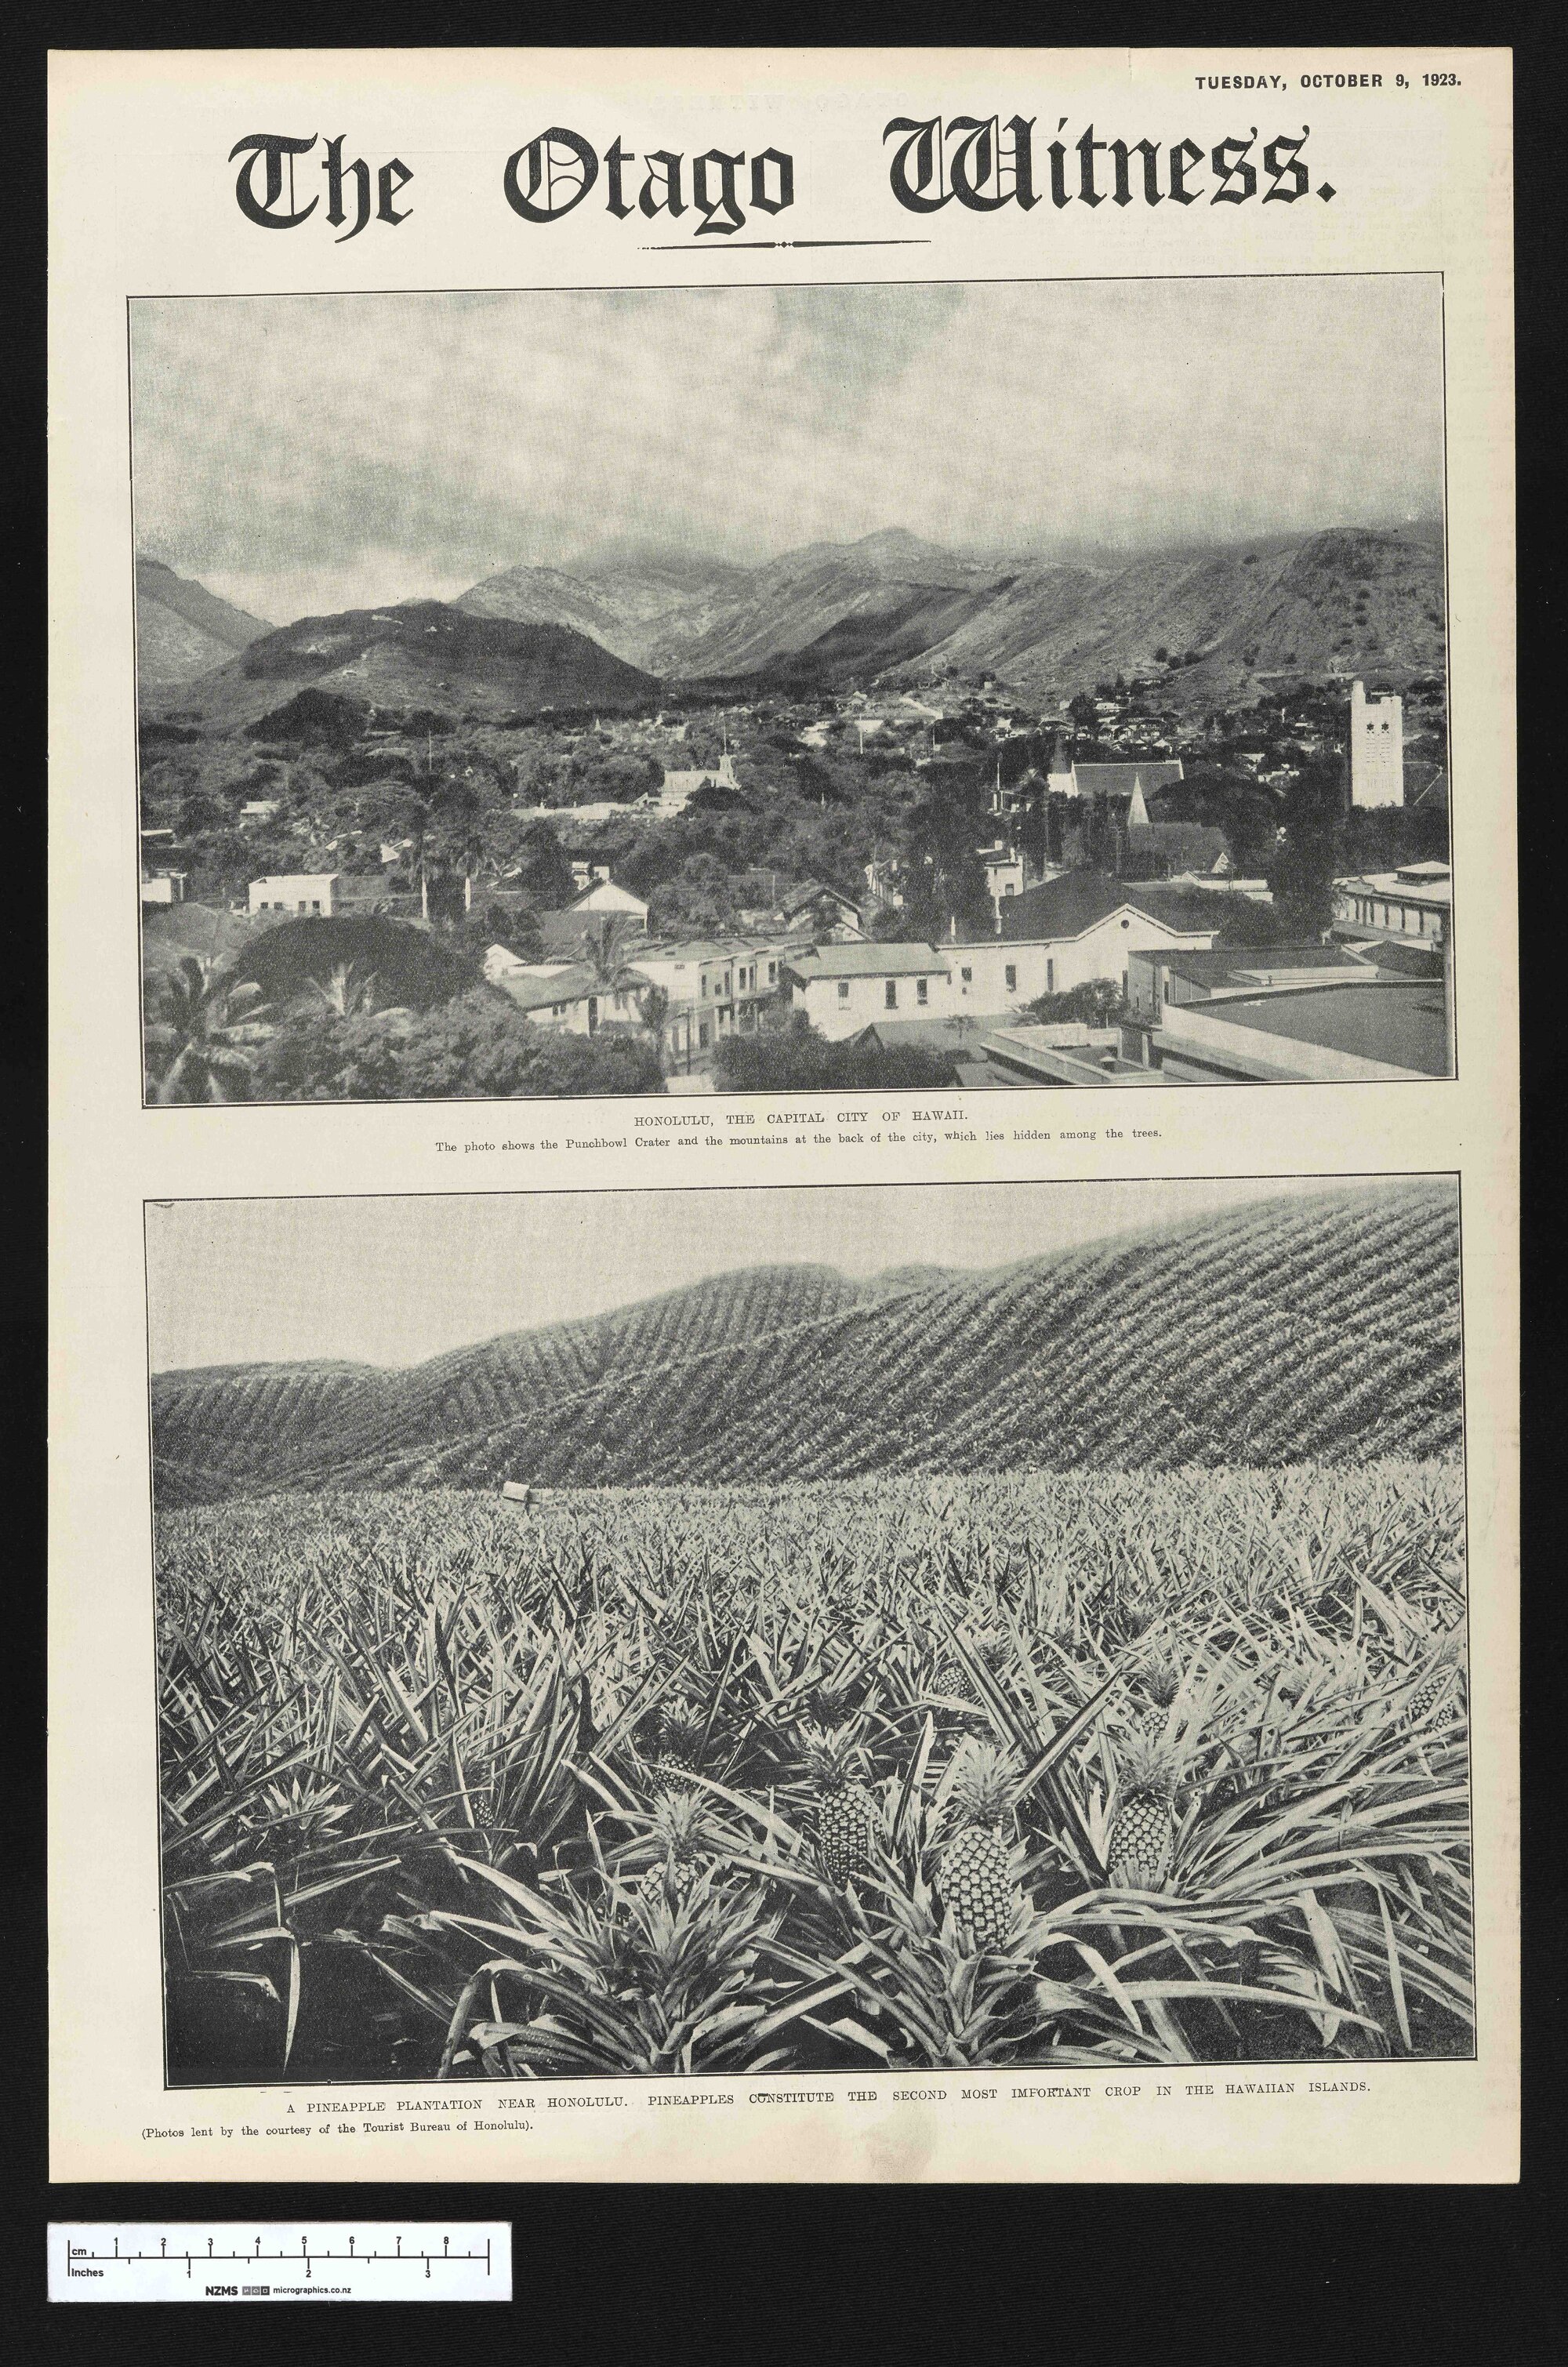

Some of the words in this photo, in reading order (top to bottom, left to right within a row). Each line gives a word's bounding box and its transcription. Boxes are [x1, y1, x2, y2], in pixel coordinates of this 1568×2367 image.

[1195, 75, 1287, 92] TUESDAY,
[1300, 74, 1383, 89] OCTOBER
[1396, 74, 1410, 89] 9,
[1422, 73, 1461, 86] 1923.
[227, 132, 415, 244] The
[503, 126, 794, 237] Otago
[882, 114, 1337, 214] Witness.
[633, 1115, 713, 1127] HONOLULU,
[726, 1114, 755, 1124] THE
[767, 1113, 825, 1124] CAPITAL
[837, 1112, 869, 1123] CITY
[881, 1112, 901, 1122] OF
[912, 1110, 967, 1121] HAWAII.
[435, 1142, 457, 1152] The
[464, 1141, 495, 1153] photo
[502, 1140, 535, 1151] shows
[539, 1139, 558, 1149] the
[565, 1138, 627, 1149] Punchbowl
[635, 1137, 670, 1147] Crater
[677, 1136, 699, 1145] and
[704, 1135, 723, 1145] the
[729, 1135, 788, 1145] mountains
[795, 1134, 807, 1144] at
[813, 1133, 831, 1144] the
[837, 1133, 864, 1143] back
[870, 1132, 881, 1142] of
[887, 1131, 906, 1142] the
[913, 1132, 937, 1143] city,
[944, 1131, 977, 1142] which
[985, 1131, 1005, 1141] lies
[1013, 1130, 1051, 1140] hidden
[1060, 1131, 1097, 1141] among
[1105, 1128, 1123, 1138] the
[1132, 1129, 1162, 1138] trees.
[286, 2104, 296, 2113] A
[307, 2101, 385, 2113] PINEAPPLE
[396, 2100, 483, 2111] PLANTATION
[497, 2098, 535, 2109] NEAR
[547, 2097, 628, 2107] HONOLULU.
[648, 2094, 734, 2106] PINEAPPLES
[848, 2091, 877, 2101] THE
[892, 2089, 947, 2101] SECOND
[961, 2089, 998, 2100] MOST
[1105, 2086, 1142, 2097] CROP
[1156, 2086, 1172, 2096] IN
[1185, 2085, 1214, 2096] THE
[1225, 2083, 1295, 2094] HAWAIIAN
[1308, 2082, 1370, 2093] ISLANDS.
[141, 2128, 184, 2140] (Photos
[191, 2127, 213, 2137] lent
[220, 2126, 234, 2138] by
[241, 2126, 259, 2136] the
[266, 2125, 312, 2136] courtesy
[318, 2123, 331, 2134] of
[337, 2123, 356, 2134] the
[363, 2122, 405, 2133] Tourist
[409, 2122, 451, 2132] Bureau
[456, 2121, 467, 2131] of
[474, 2119, 533, 2132] Honolulu).
[160, 2238, 167, 2246] 2
[207, 2238, 214, 2246] 3
[255, 2236, 262, 2245] 4
[301, 2236, 308, 2245] 5
[349, 2236, 356, 2245] 6
[396, 2236, 402, 2245] 7
[443, 2236, 450, 2245] 8
[71, 2268, 104, 2277] Inches
[187, 2270, 191, 2278] 1
[205, 2286, 238, 2296] NZMS
[273, 2286, 352, 2295] micrographics.co.nz
